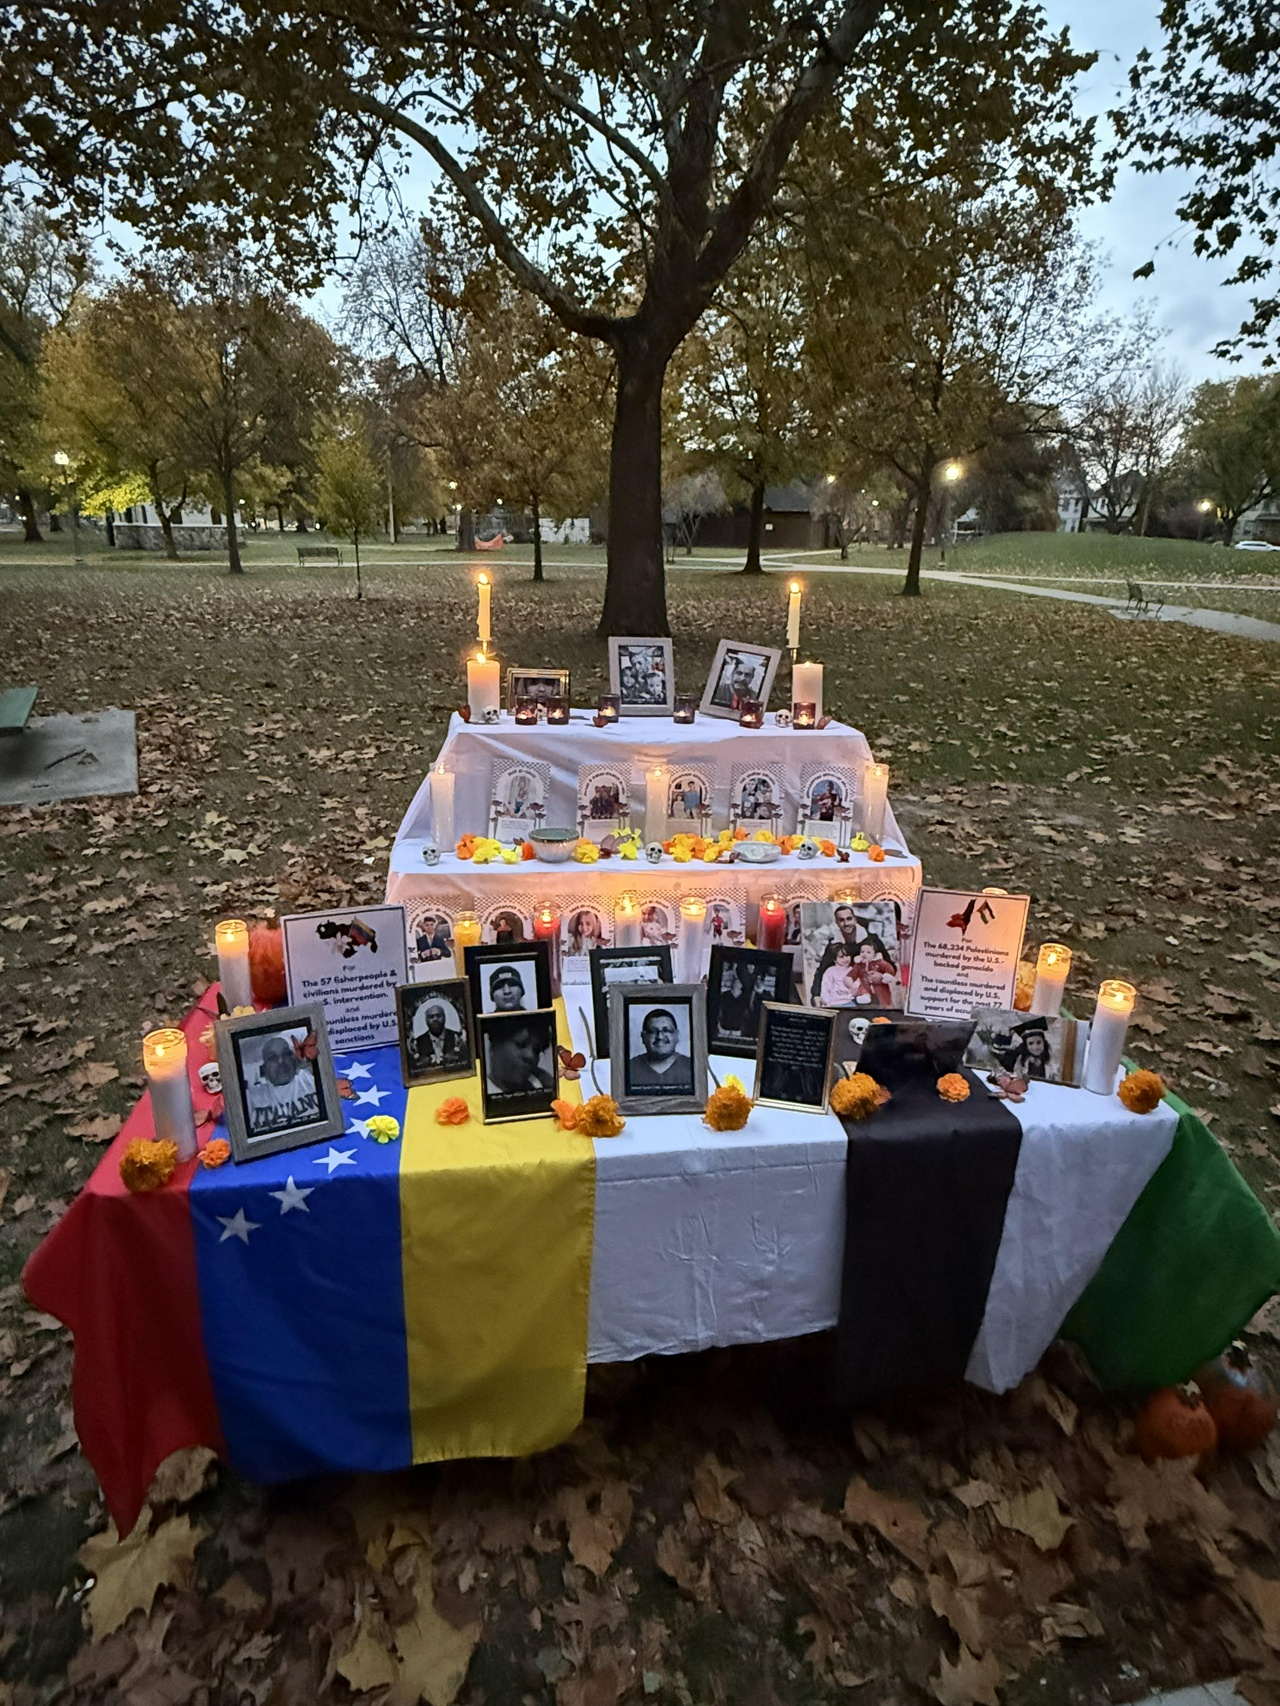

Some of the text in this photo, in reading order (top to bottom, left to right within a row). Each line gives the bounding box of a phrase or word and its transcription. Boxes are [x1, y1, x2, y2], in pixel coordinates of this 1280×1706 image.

[924, 941, 1009, 956] The 68,234 Palestinians
[925, 952, 961, 960] murdered
[962, 954, 971, 962] by
[933, 960, 994, 972] backed genocide
[302, 969, 397, 988] The 57 fisherpeople &
[921, 975, 1006, 991] The countless murdered
[303, 980, 397, 998] civilians murdered by
[939, 987, 973, 996] displaced
[974, 990, 984, 999] by
[333, 991, 388, 1004] intervention.
[920, 995, 948, 1003] support
[924, 1004, 944, 1012] years
[369, 1022, 380, 1031] by
[335, 1034, 375, 1045] sanctions
